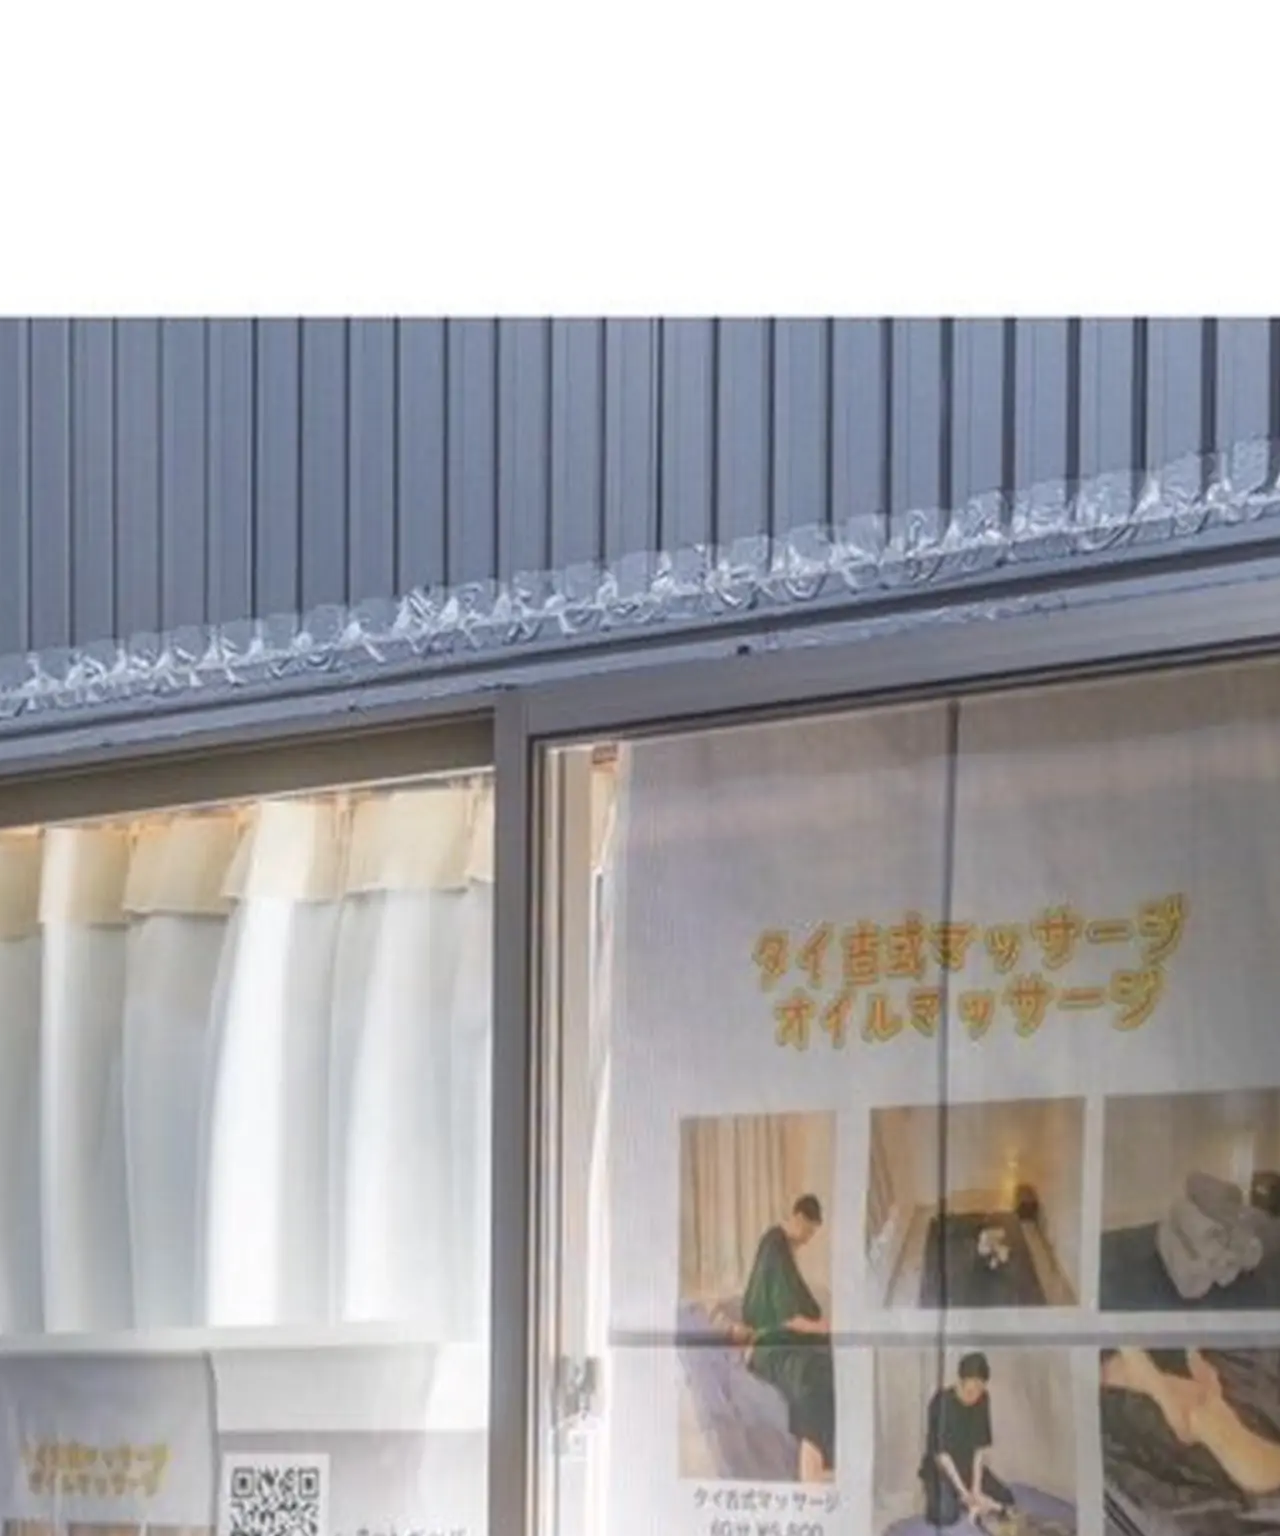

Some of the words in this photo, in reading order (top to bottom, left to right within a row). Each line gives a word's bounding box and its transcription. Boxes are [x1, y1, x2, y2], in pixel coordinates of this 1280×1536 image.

[752, 893, 1186, 991] タイ古式マッサージ
[774, 965, 1163, 1051] オイルマッサージ
